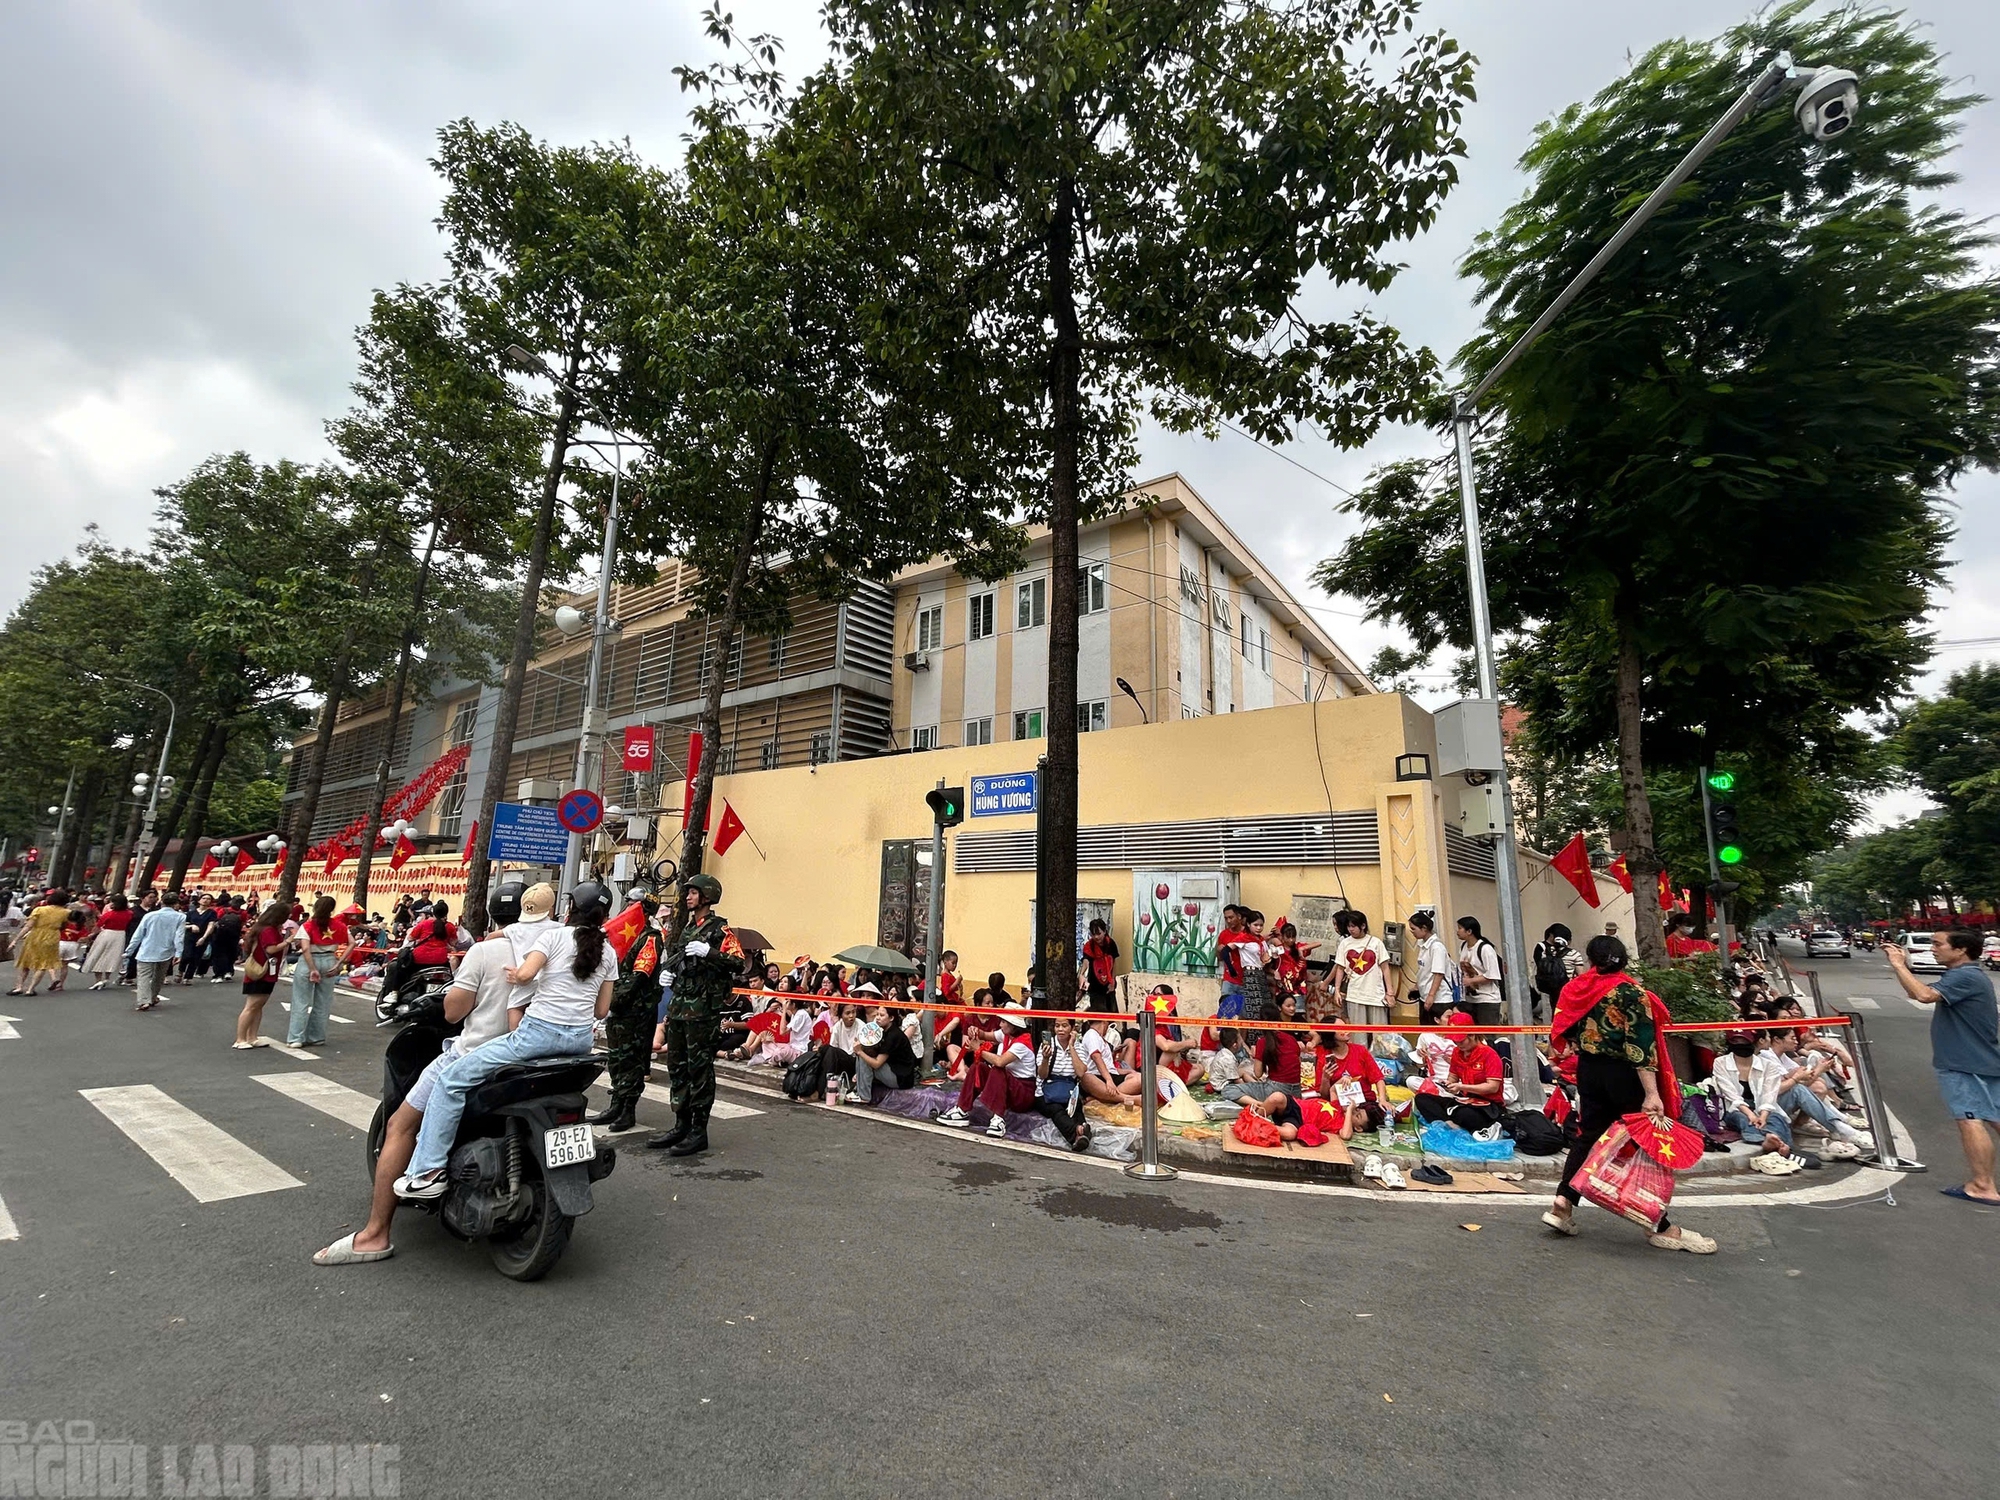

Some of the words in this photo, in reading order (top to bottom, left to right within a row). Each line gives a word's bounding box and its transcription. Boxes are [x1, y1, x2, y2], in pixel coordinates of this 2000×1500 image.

[627, 744, 650, 758] 5G
[990, 778, 1026, 789] ĐƯỜNG
[975, 793, 999, 810] HÙNG
[1001, 792, 1031, 808] VƯƠNG
[553, 1127, 586, 1147] 29-E2
[550, 1142, 592, 1165] 596.04
